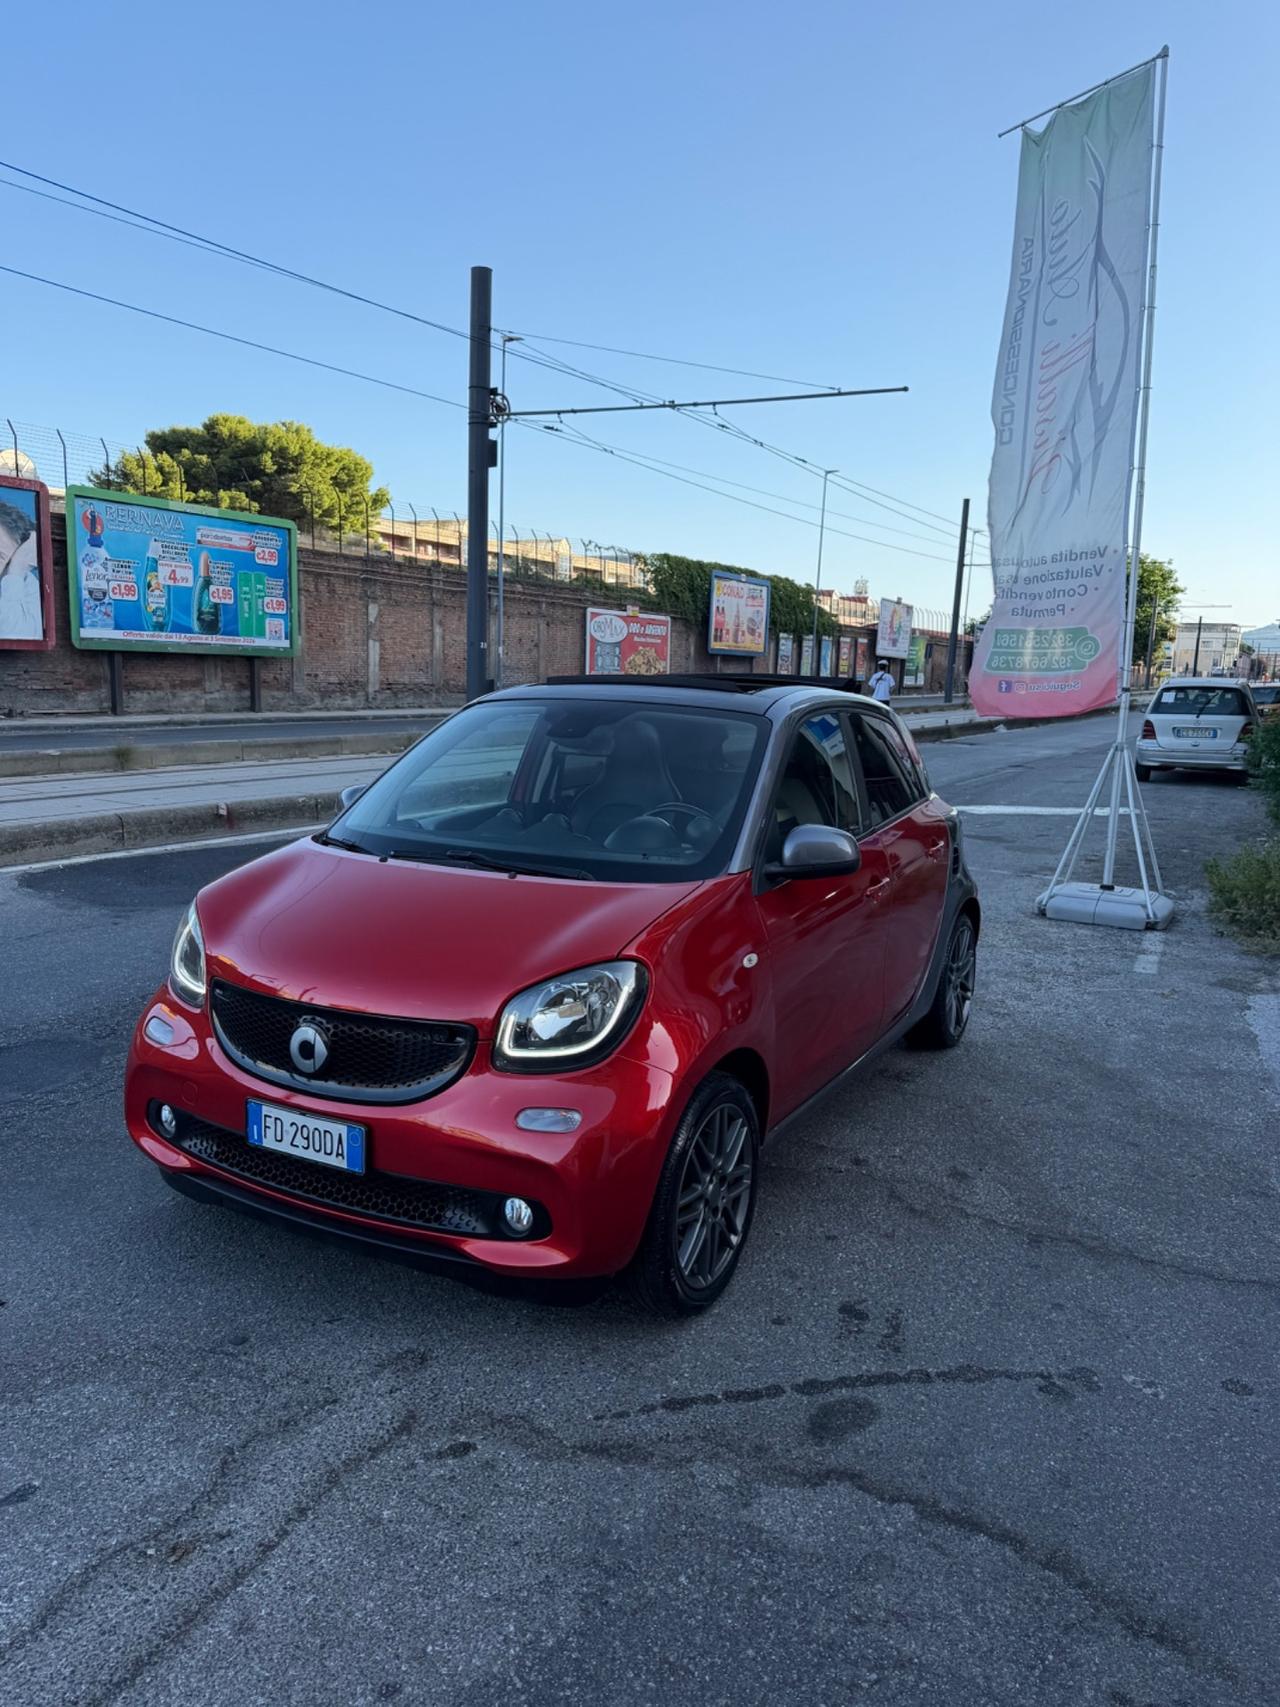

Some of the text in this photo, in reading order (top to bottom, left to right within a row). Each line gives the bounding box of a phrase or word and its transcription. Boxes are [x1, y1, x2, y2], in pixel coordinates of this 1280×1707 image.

[105, 505, 185, 530] BERNAVA
[263, 1114, 284, 1143] FD
[290, 1122, 345, 1160] 290DA
